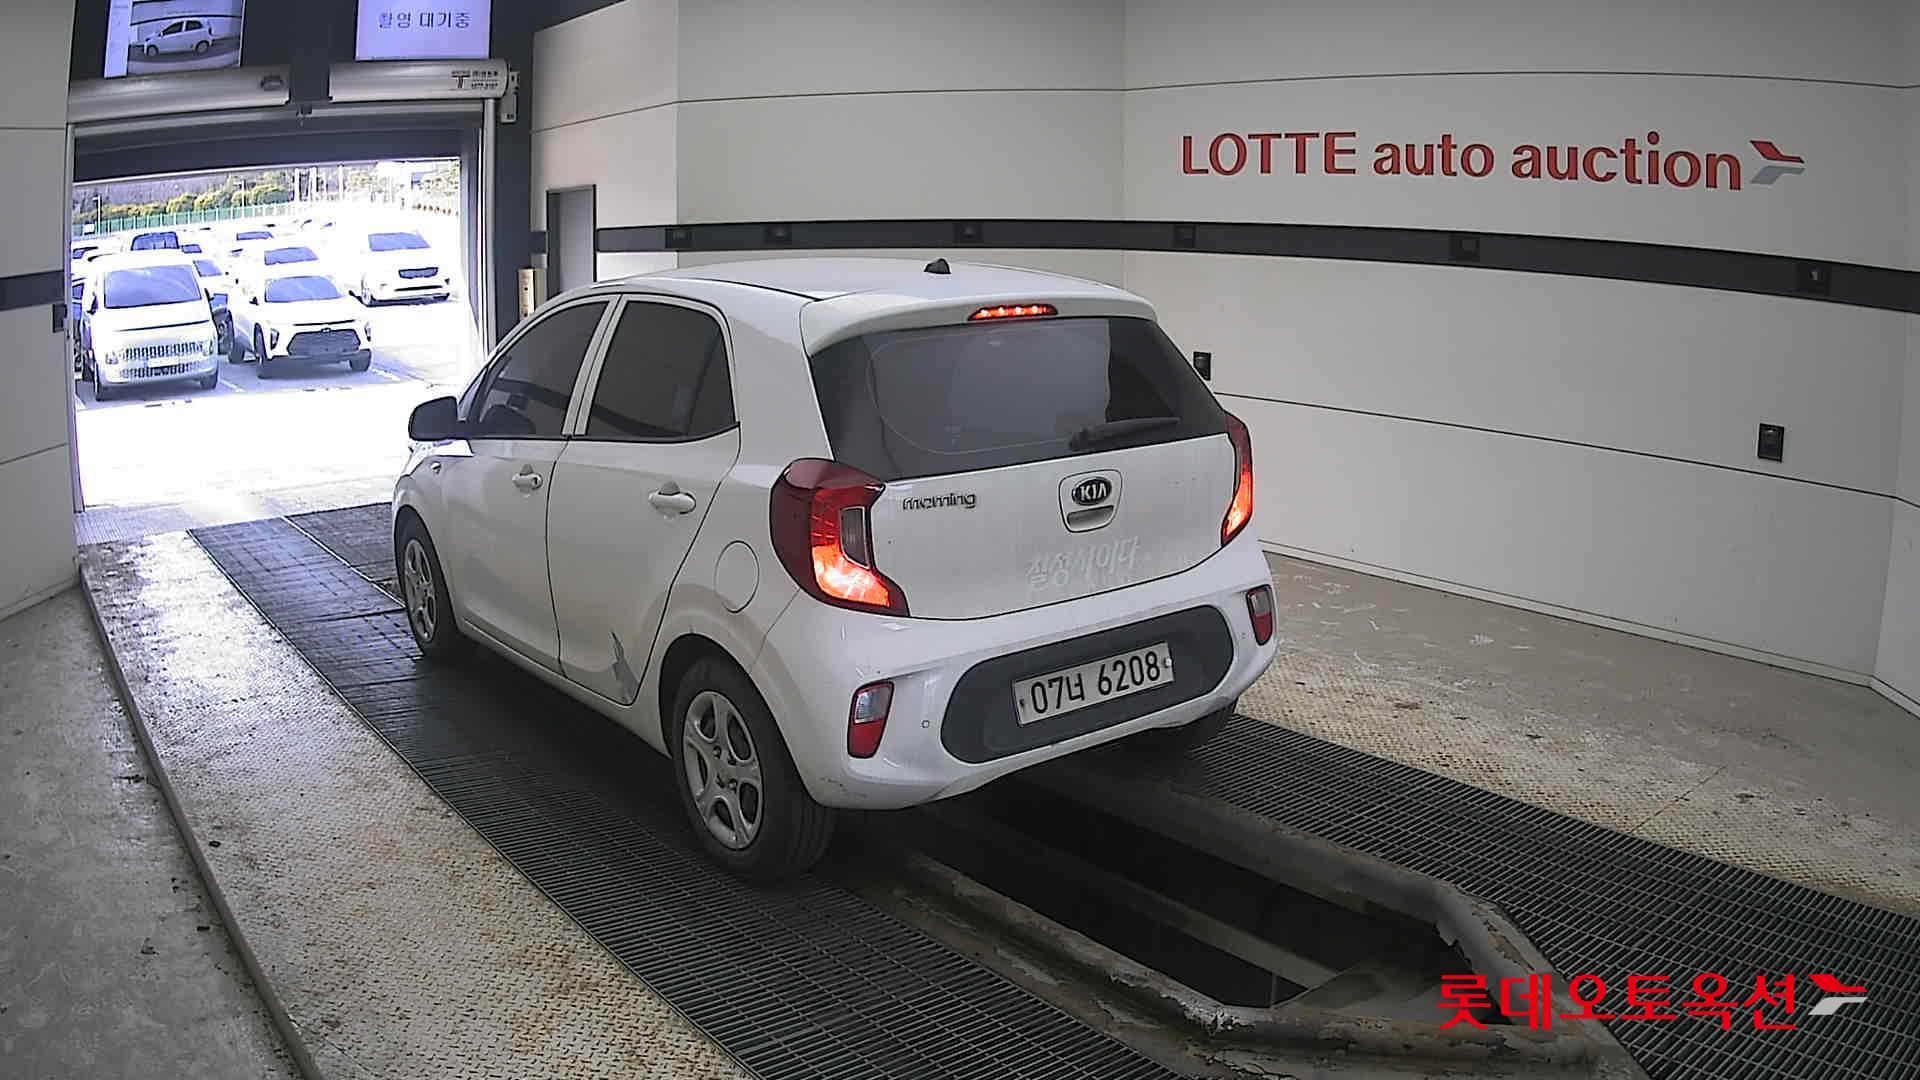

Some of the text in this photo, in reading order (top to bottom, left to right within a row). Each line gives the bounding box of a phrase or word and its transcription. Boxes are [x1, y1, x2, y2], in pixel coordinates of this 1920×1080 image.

[419, 11, 473, 29] 대기중
[1181, 131, 1742, 191] LOTTE auto auction
[1079, 483, 1108, 502] KIA
[1030, 650, 1161, 714] 07너 6208
